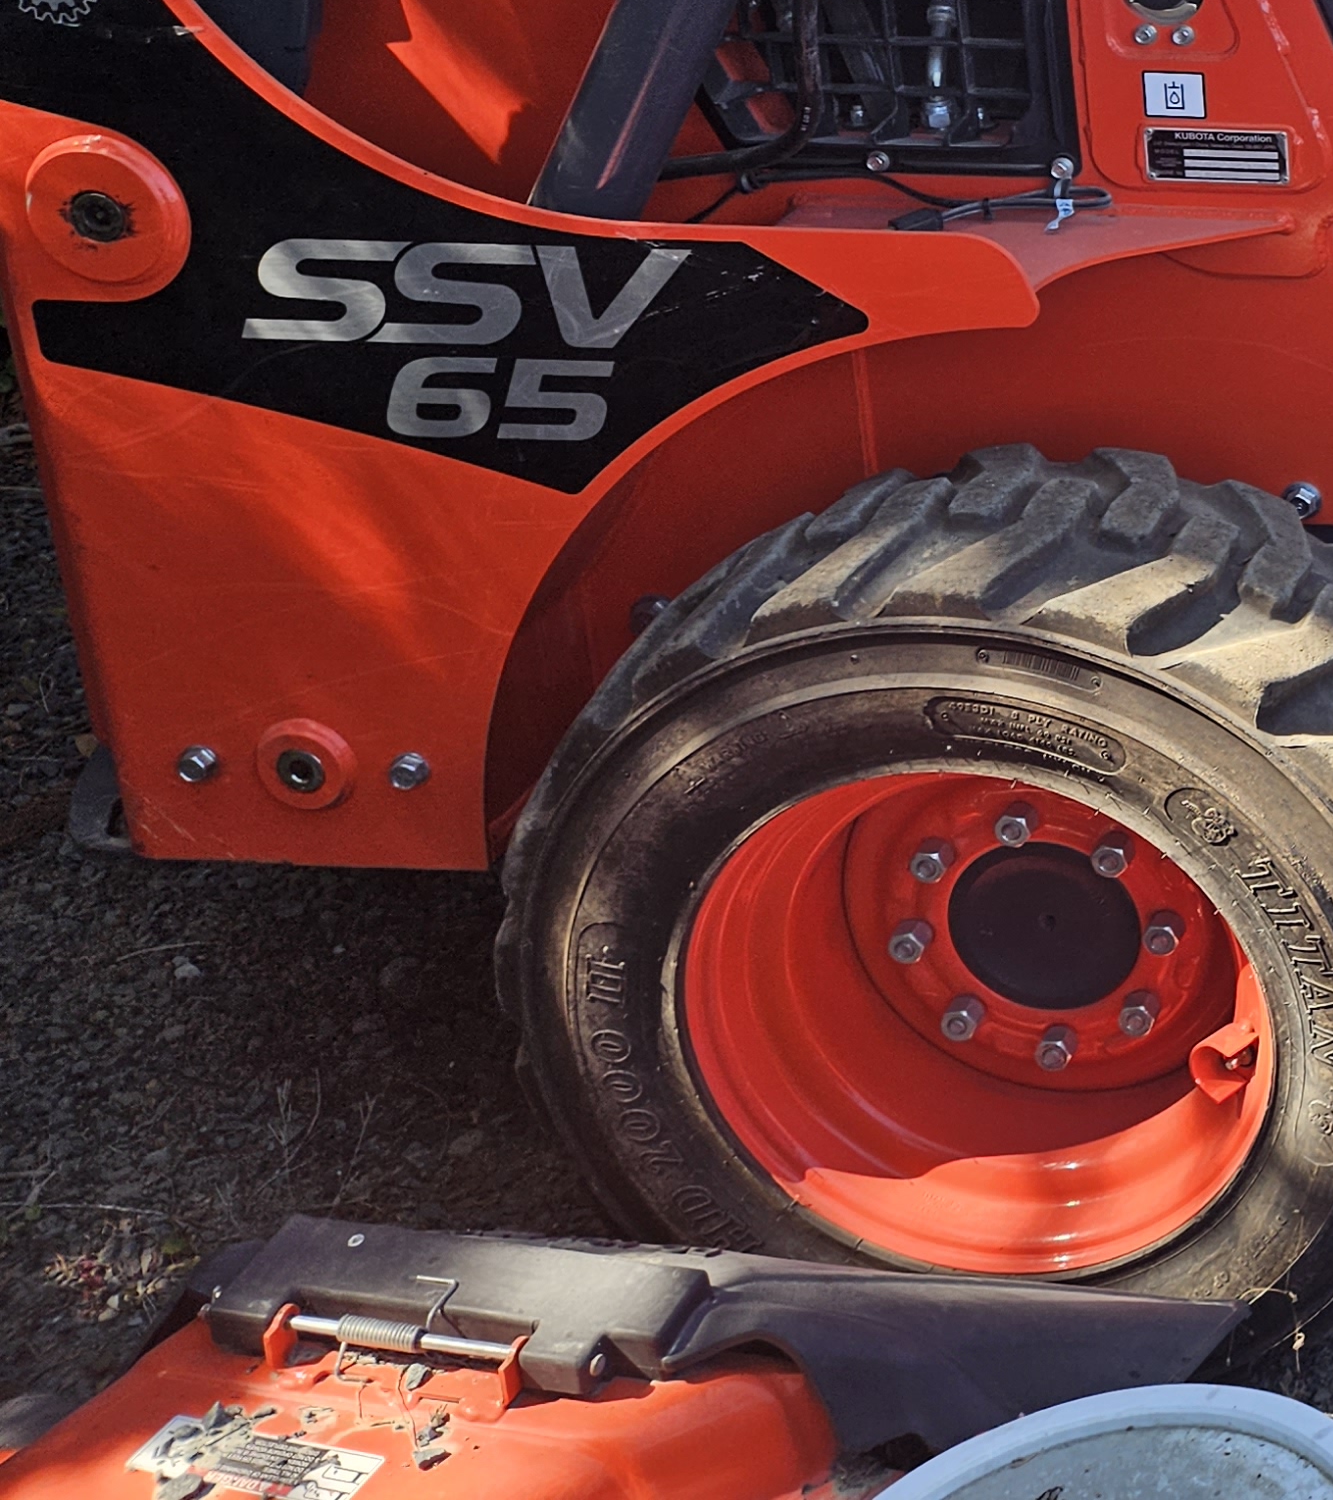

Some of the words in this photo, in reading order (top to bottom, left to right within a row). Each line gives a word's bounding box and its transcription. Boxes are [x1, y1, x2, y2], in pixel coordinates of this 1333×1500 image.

[1174, 131, 1215, 141] KUBOTA
[1216, 132, 1273, 144] Corporation
[242, 238, 693, 348] SSV
[386, 356, 615, 441] 65
[1027, 713, 1053, 729] PLY
[1062, 724, 1108, 749] RATING
